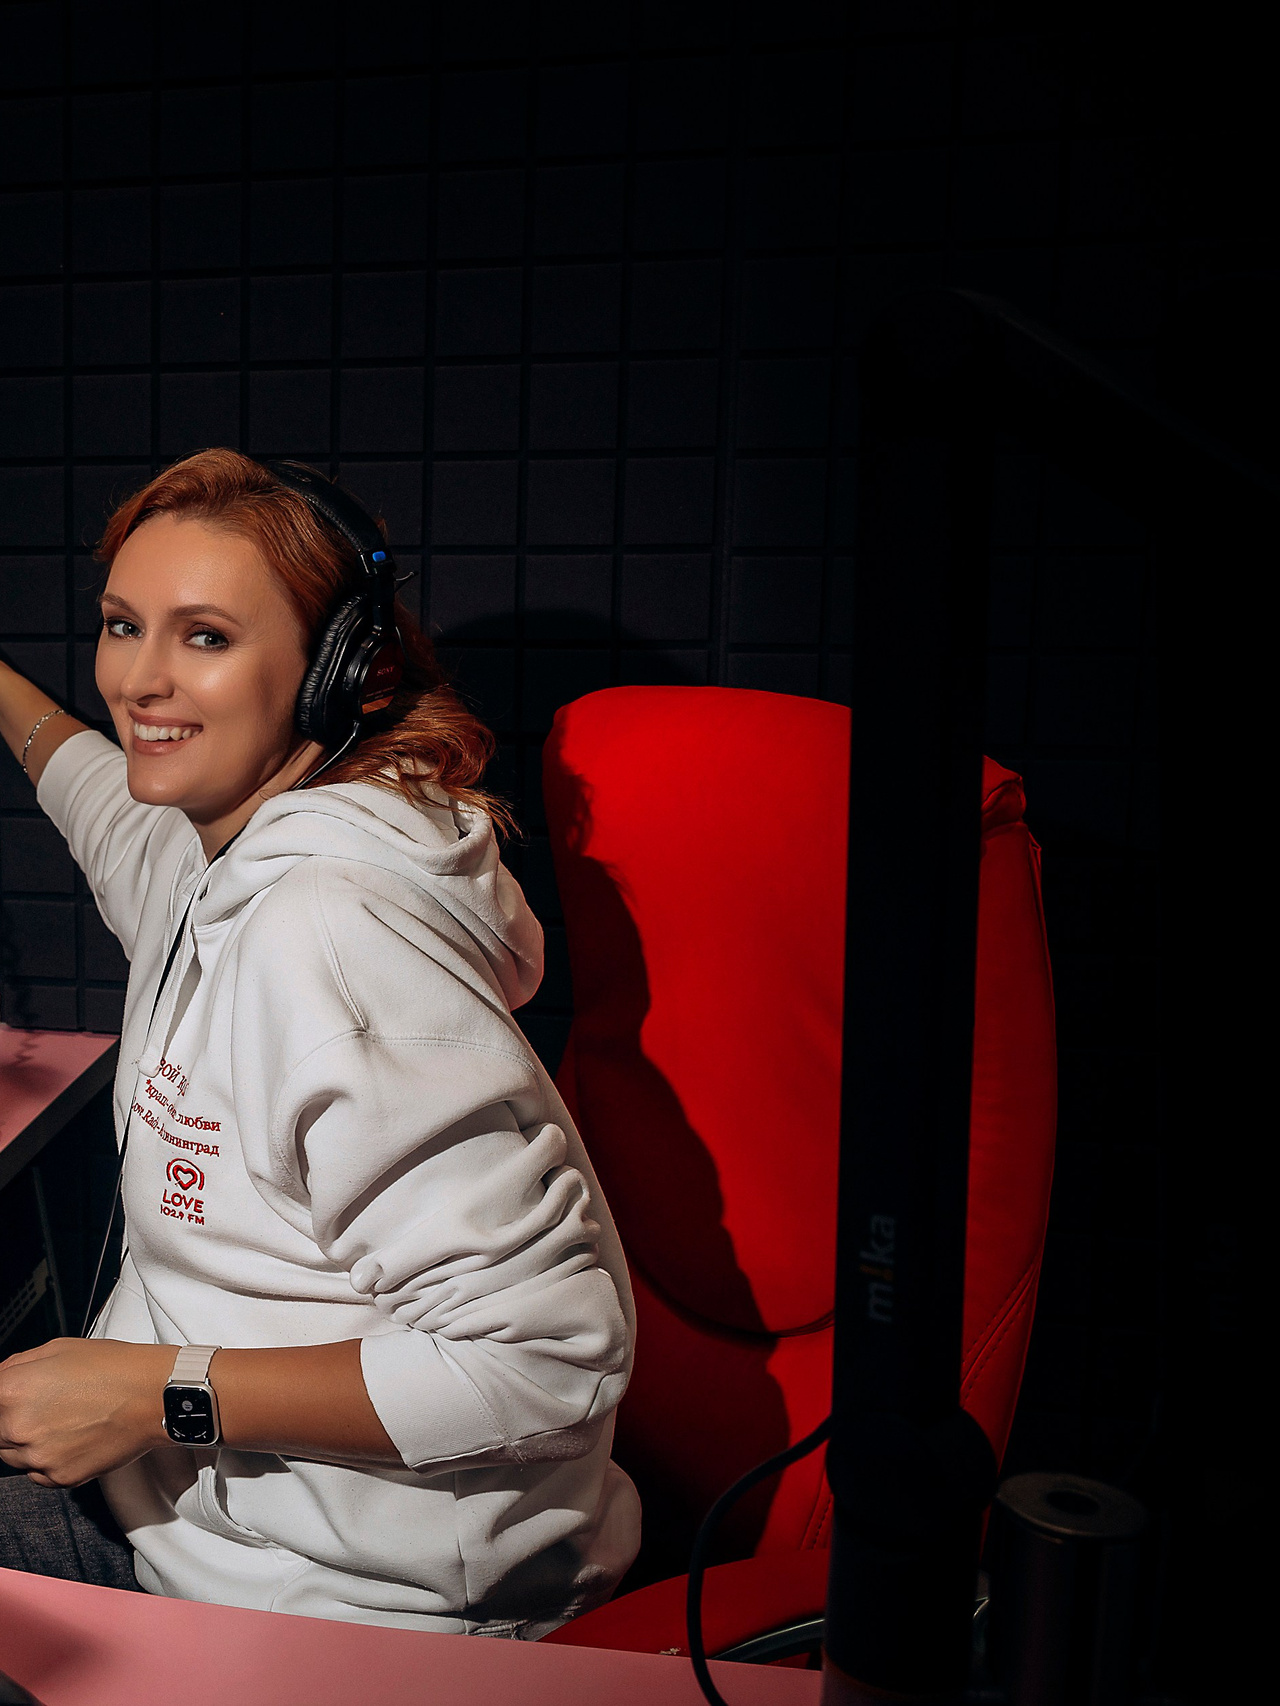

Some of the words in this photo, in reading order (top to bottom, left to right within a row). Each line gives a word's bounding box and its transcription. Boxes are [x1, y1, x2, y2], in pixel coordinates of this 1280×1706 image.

[162, 1189, 204, 1213] LOVE
[160, 1204, 185, 1220] 102.9
[187, 1213, 205, 1225] FM
[858, 1213, 898, 1323] mika
